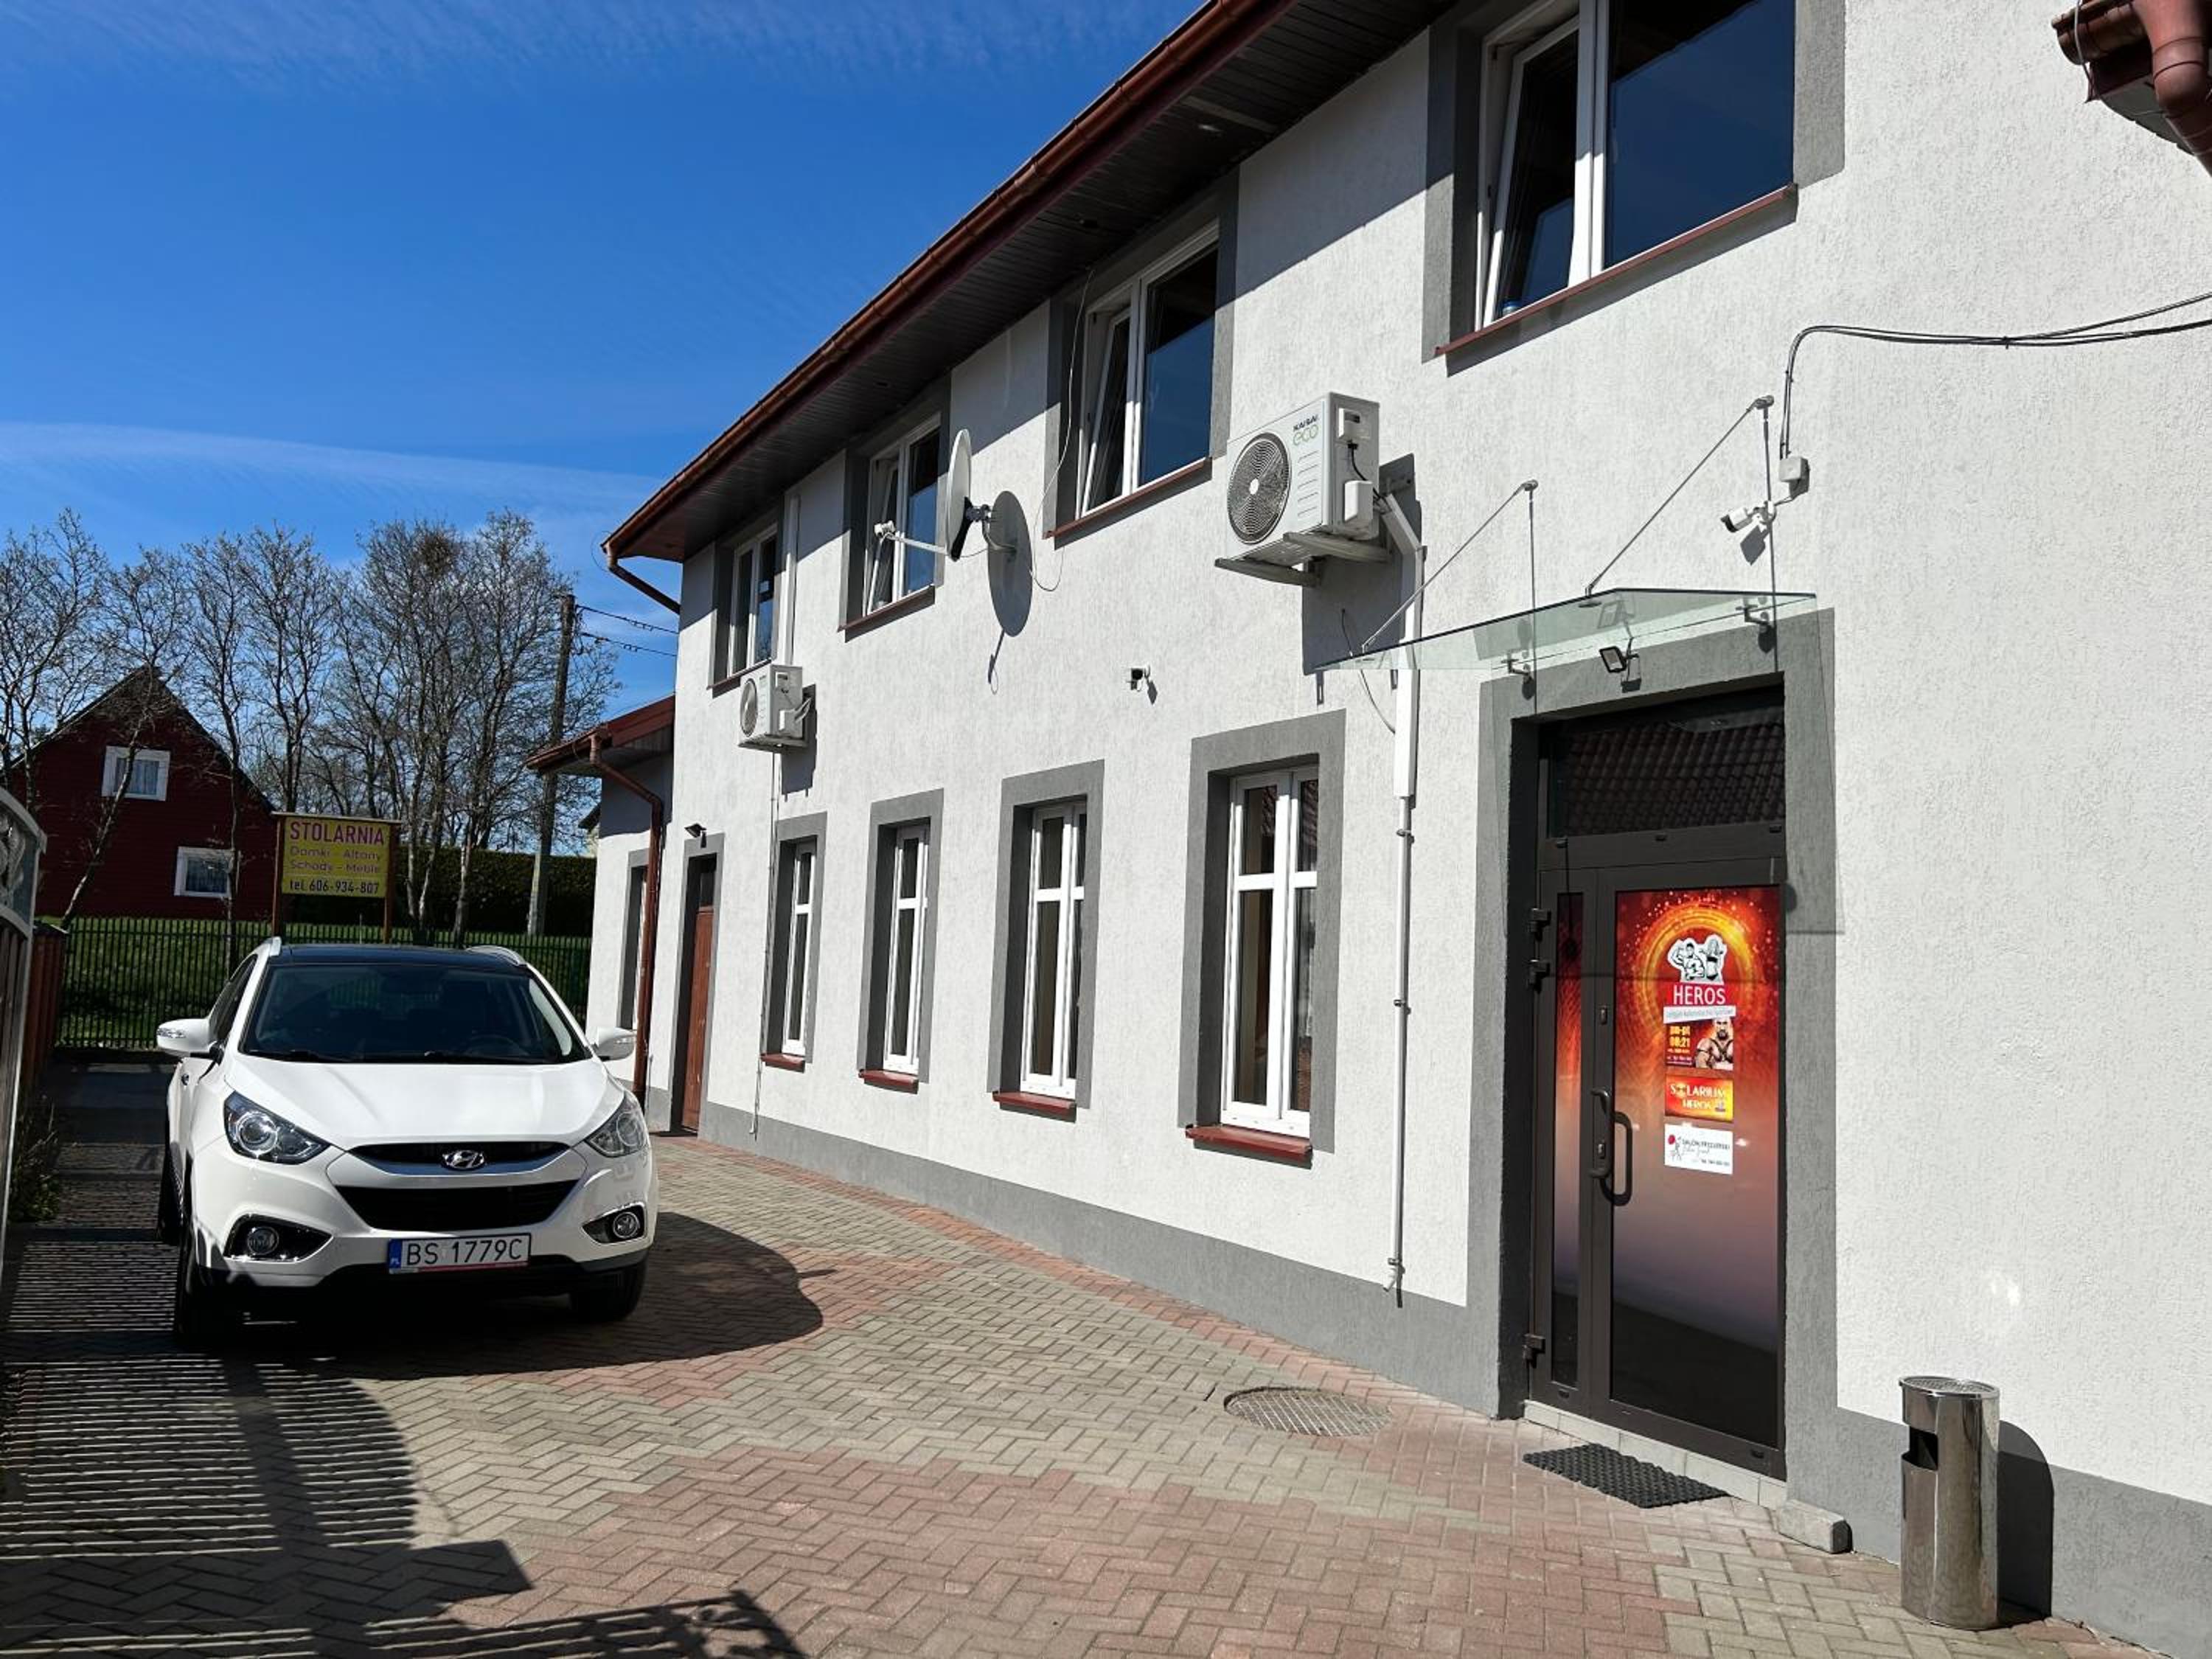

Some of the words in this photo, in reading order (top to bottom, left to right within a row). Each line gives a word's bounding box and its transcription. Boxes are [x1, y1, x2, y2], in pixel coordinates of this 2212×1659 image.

[290, 821, 384, 845] STOLARNIA
[309, 880, 380, 894] 606-934-807
[1673, 985, 1726, 1005] HEROS
[406, 1242, 439, 1266] BS
[452, 1238, 522, 1264] 1779C
